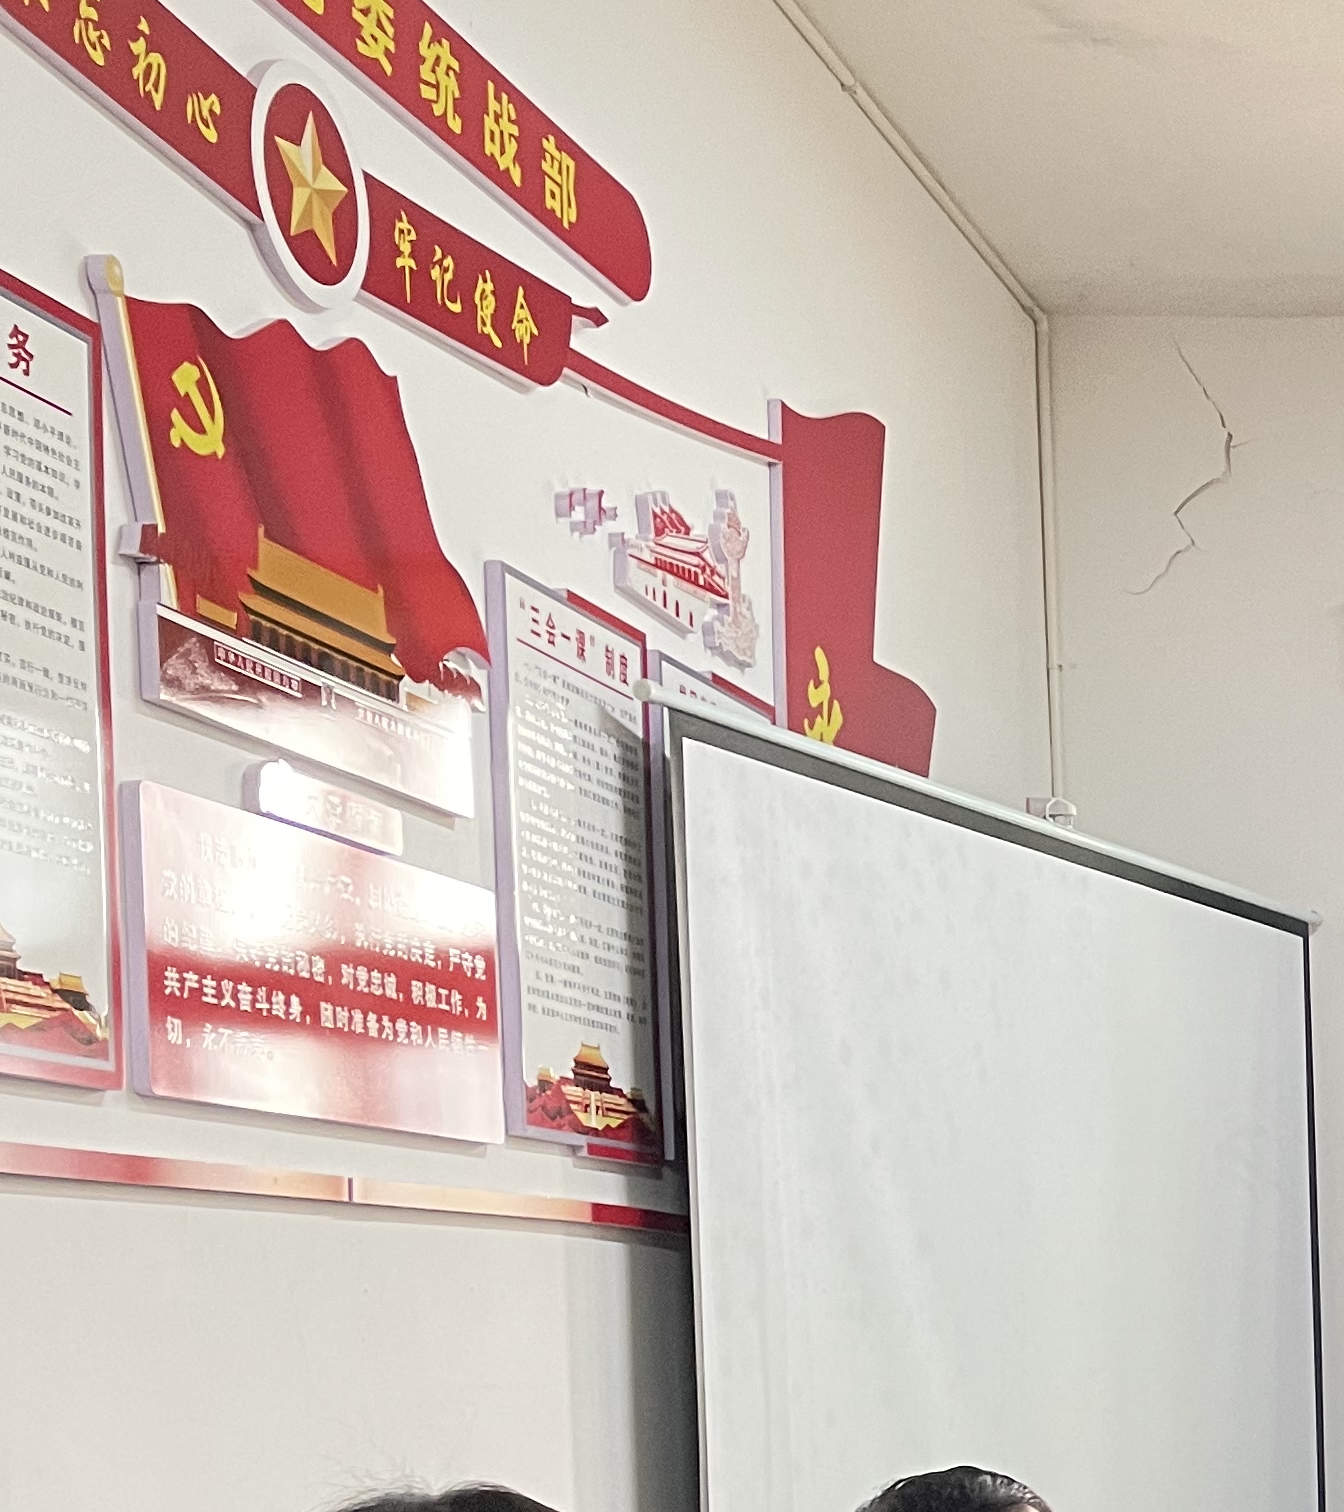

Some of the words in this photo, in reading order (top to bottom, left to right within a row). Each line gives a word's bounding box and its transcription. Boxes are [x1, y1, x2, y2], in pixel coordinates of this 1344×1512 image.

[24, 0, 221, 143] 忘初心
[302, 0, 577, 229] 委统战部
[6, 323, 34, 377] 务
[393, 210, 538, 365] 牢记使命
